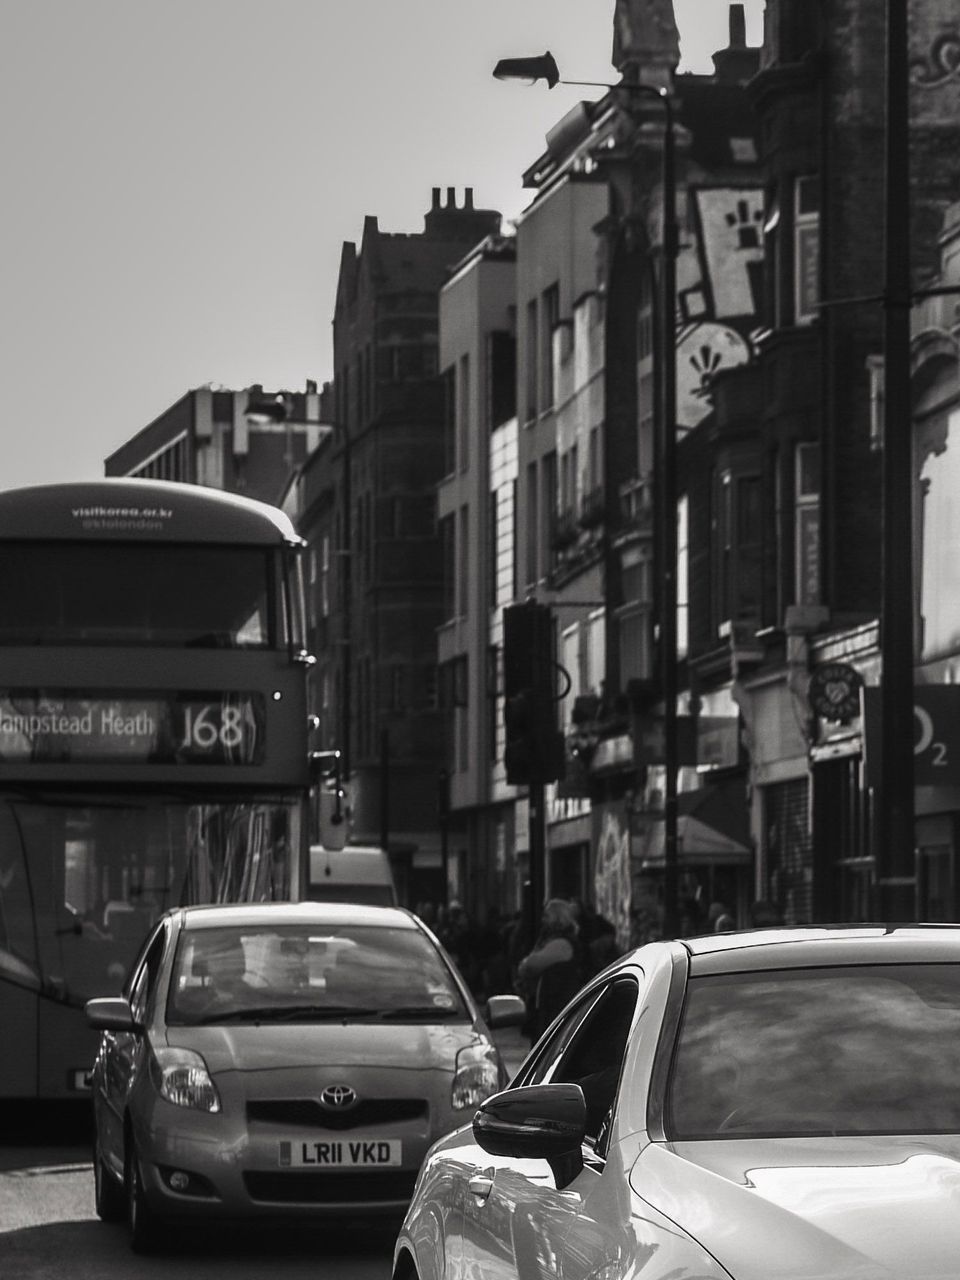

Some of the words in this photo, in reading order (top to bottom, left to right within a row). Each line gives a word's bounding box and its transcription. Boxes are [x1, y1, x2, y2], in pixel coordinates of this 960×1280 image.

[72, 506, 173, 518] visitkorea.or.kr
[0, 707, 92, 740] ampstead
[101, 709, 154, 735] Heath
[184, 706, 243, 747] 168
[302, 1142, 342, 1164] LR11
[348, 1142, 391, 1163] VKD
